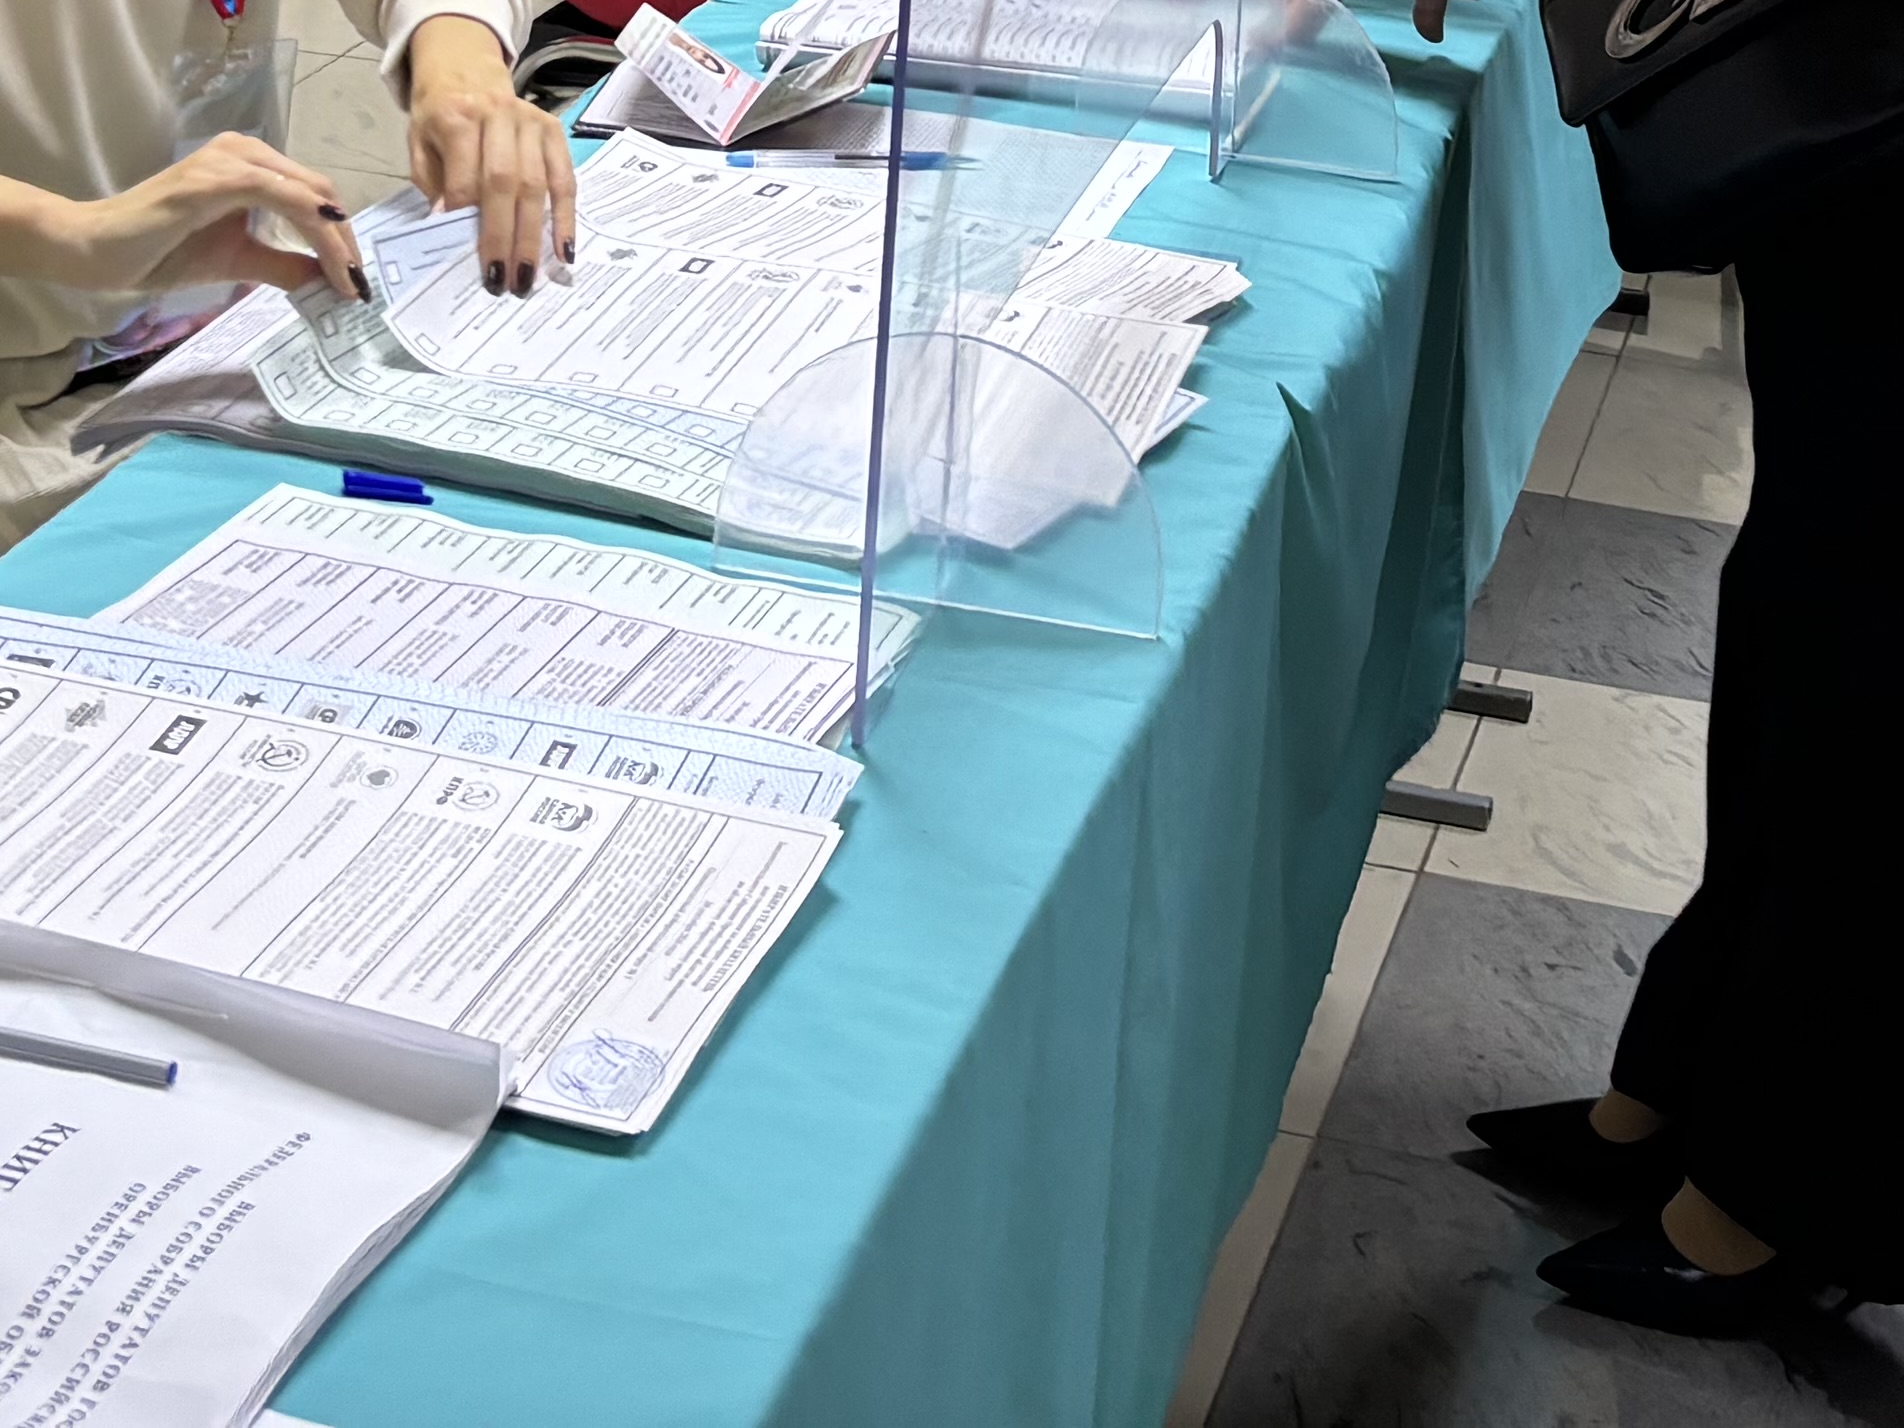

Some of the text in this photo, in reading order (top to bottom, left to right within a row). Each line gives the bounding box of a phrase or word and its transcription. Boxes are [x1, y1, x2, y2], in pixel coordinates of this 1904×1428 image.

[164, 719, 196, 751] ЛДПР
[433, 778, 464, 806] КПРФ
[128, 1164, 201, 1227] ВЫБОРЫ
[183, 1199, 256, 1273] ВЫБОРЫ
[18, 1181, 146, 1322] ОРЕНБУРГСКОЙ
[21, 1131, 311, 1427] ФЕДЕРАЛЬНОГО СОБРАНИЯ РОССИЙСК
[35, 1226, 134, 1339] ДЕПУТАТОВ
[91, 1273, 189, 1393] ДЕПУТАТОВ
